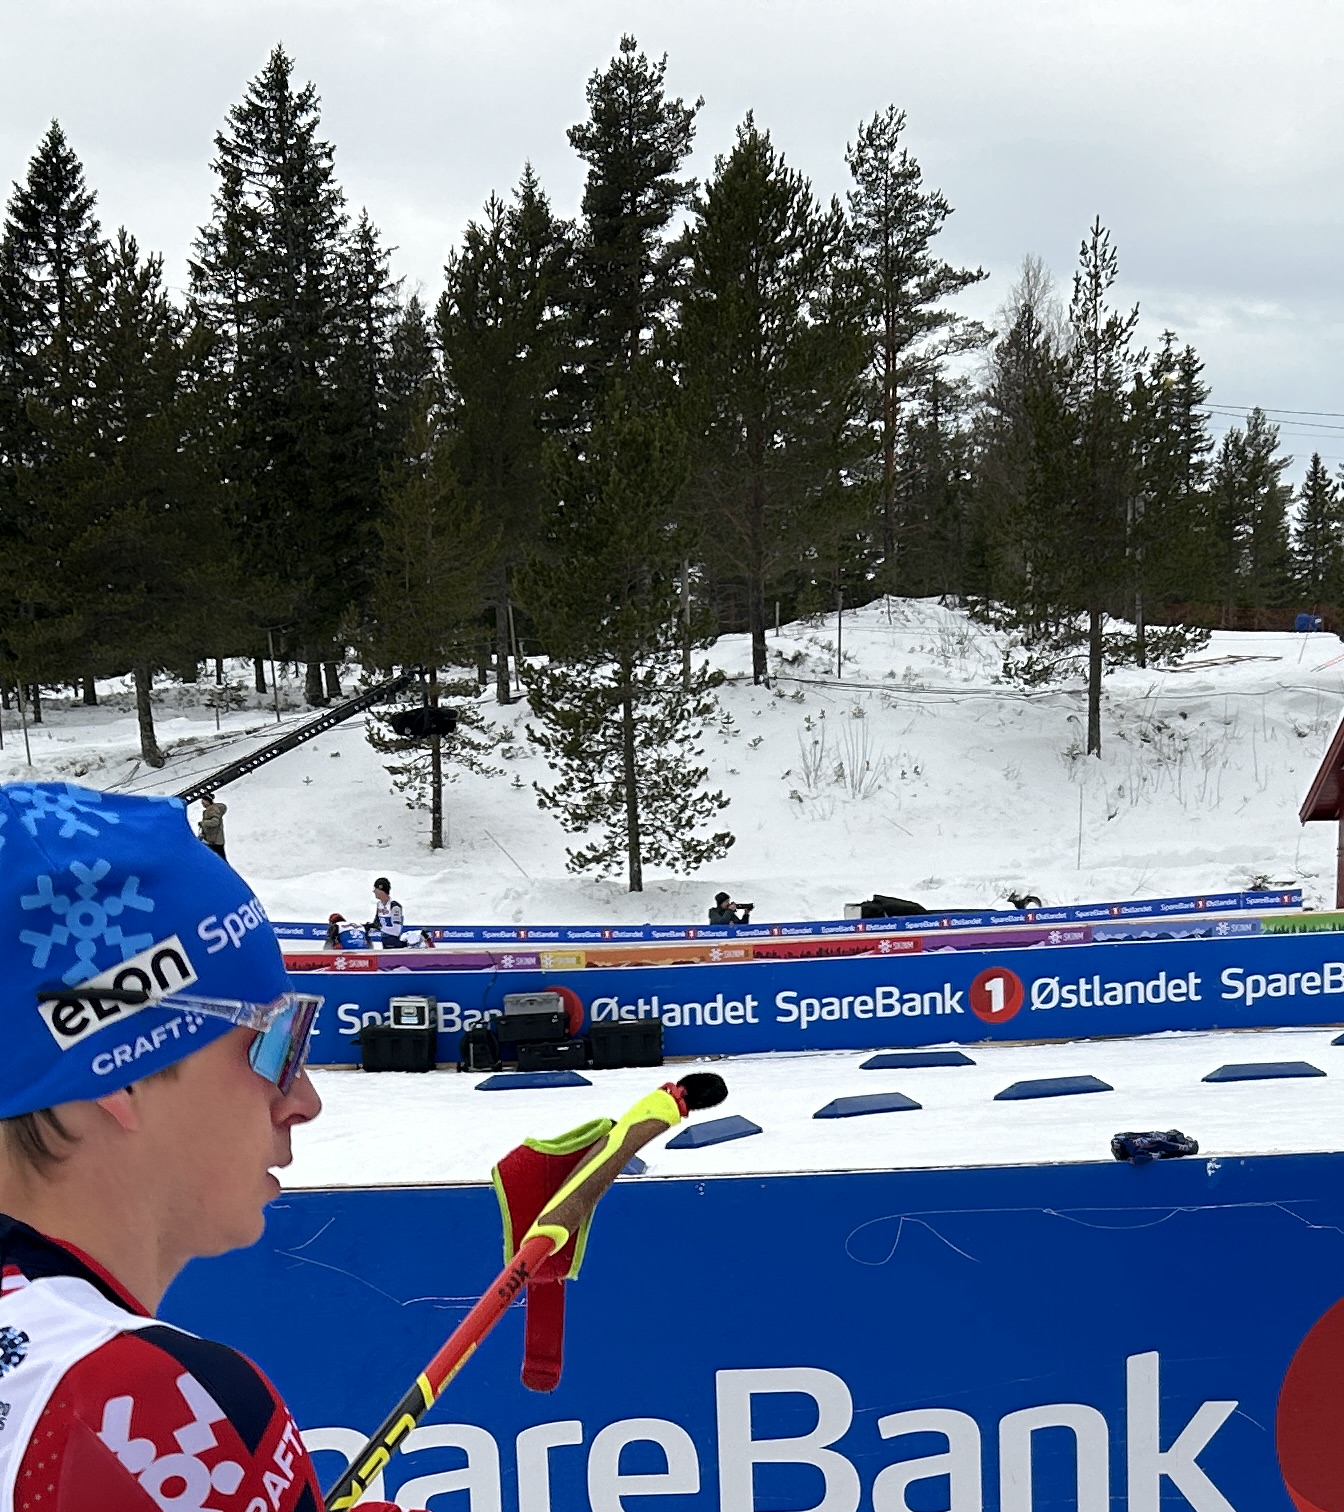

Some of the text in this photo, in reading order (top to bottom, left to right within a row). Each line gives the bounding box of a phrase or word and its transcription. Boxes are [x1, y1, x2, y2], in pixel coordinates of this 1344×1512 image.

[775, 981, 965, 1031] SpareBank
[1030, 970, 1202, 1012] Østlandet
[90, 1020, 182, 1076] CRAFT
